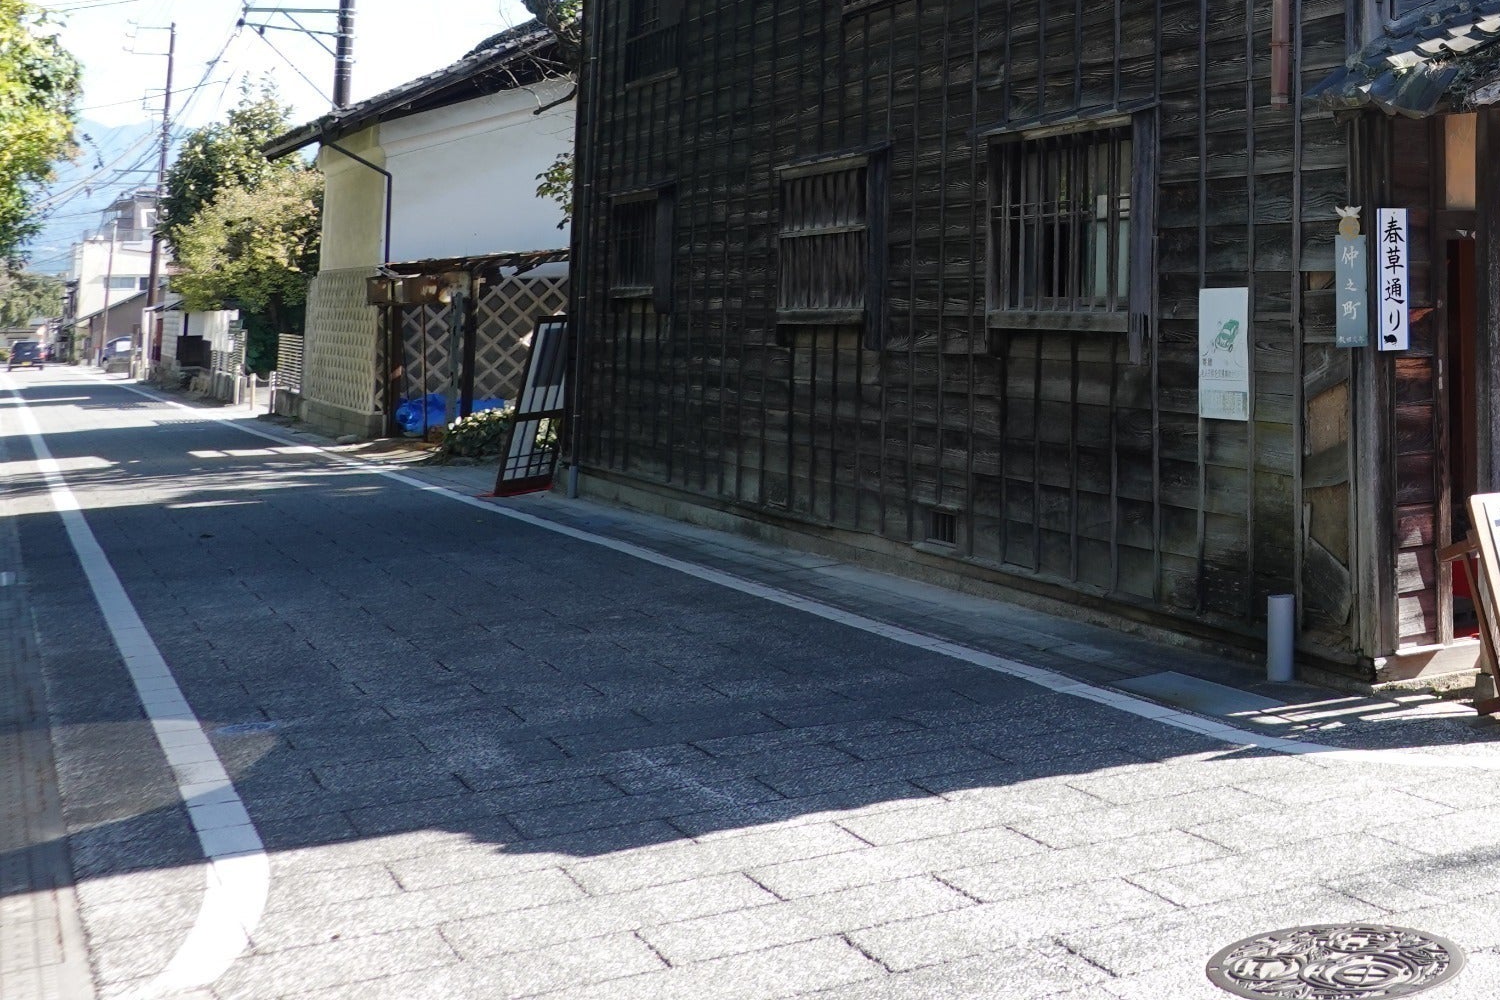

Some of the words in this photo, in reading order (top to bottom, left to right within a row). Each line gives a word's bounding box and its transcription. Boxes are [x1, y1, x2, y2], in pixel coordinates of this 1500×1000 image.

[1341, 245, 1361, 320] 仲之町
[1383, 216, 1405, 331] 春草通り
